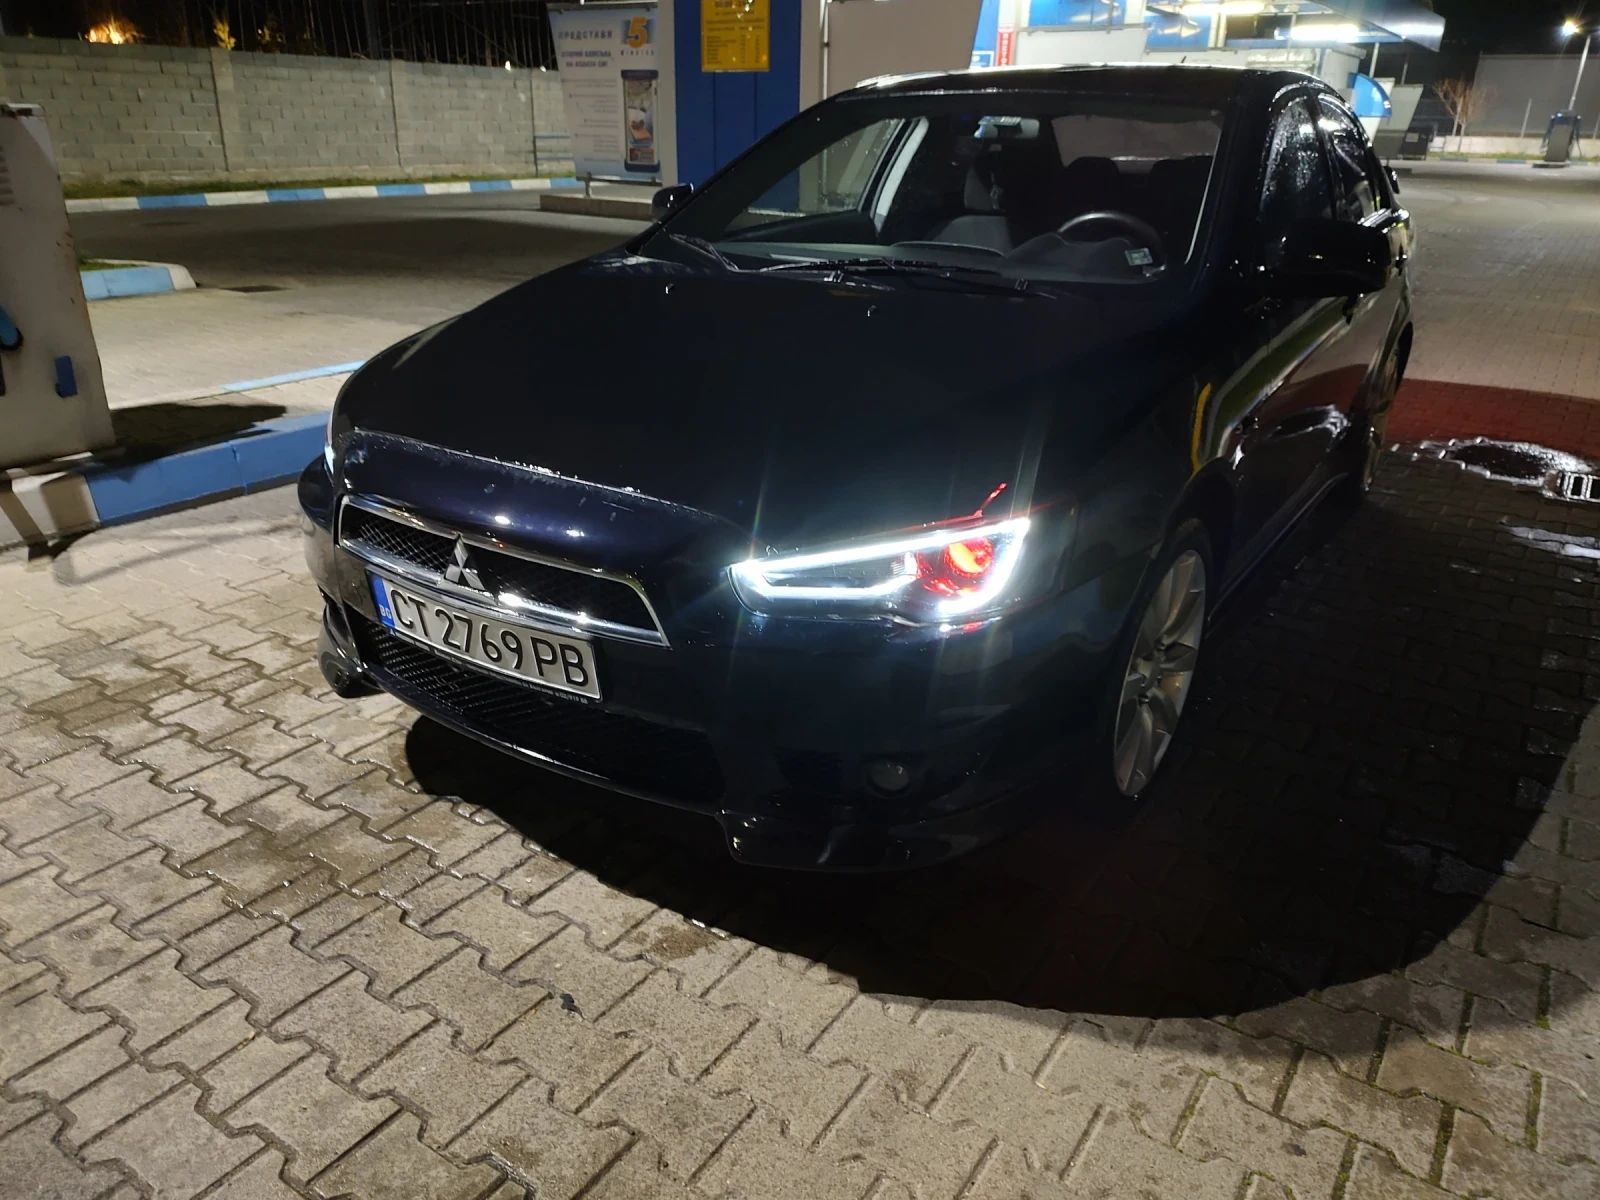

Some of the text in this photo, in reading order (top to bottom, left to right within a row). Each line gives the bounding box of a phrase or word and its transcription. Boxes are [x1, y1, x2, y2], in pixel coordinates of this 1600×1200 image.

[378, 603, 392, 620] BG
[390, 589, 589, 687] CT 2769 PB
